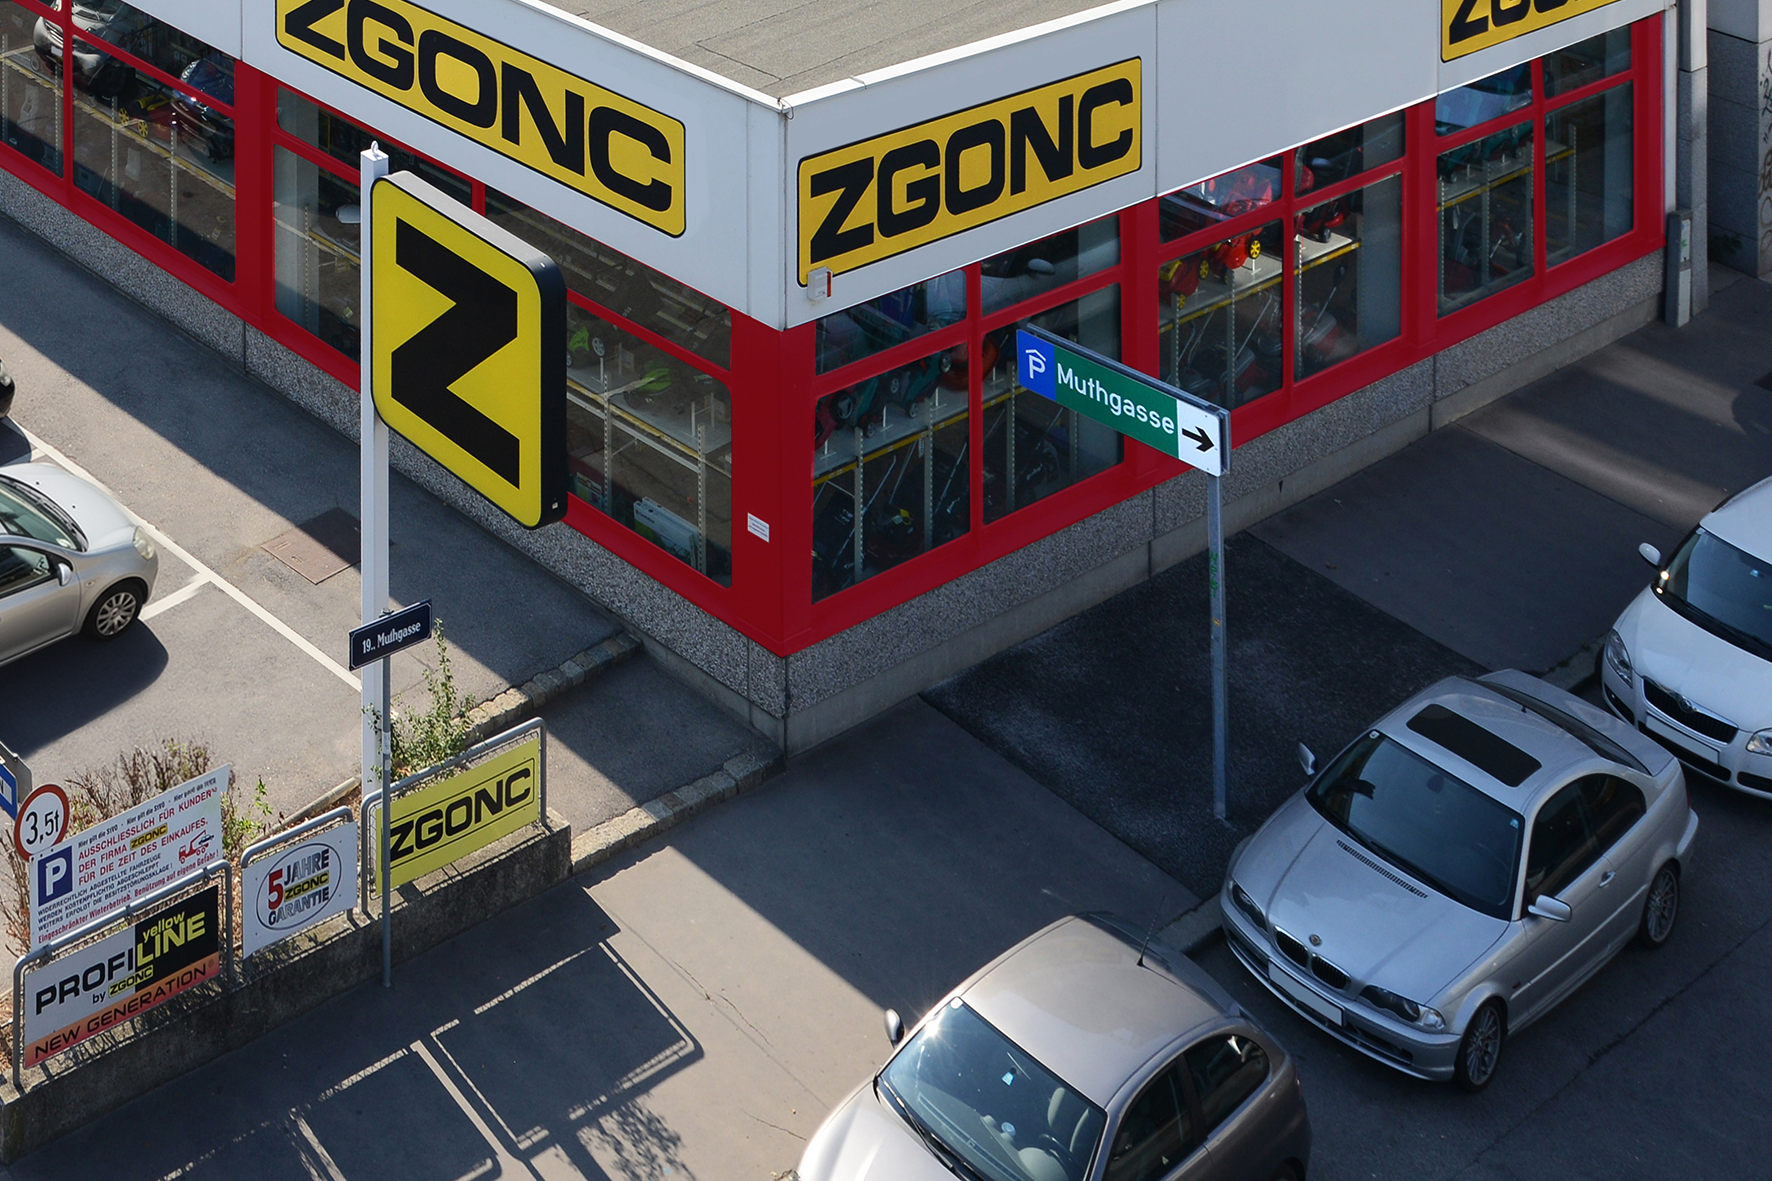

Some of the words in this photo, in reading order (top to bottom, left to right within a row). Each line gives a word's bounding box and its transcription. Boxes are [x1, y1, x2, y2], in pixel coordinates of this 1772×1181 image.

[810, 77, 1134, 265] ZGONC
[391, 216, 520, 490] Z
[1057, 363, 1175, 435] Muthgasse
[377, 622, 421, 649] Muthgasse
[26, 809, 59, 845] 3,5t
[78, 817, 155, 861] AUSSCHLIESSLICH
[159, 807, 175, 822] FÜR
[390, 766, 531, 863] ZGONC
[78, 858, 96, 873] DER
[100, 844, 127, 863] FIRMA
[131, 825, 167, 849] ZGONC
[78, 871, 96, 886] FÜR
[100, 862, 114, 876] DIE
[118, 851, 136, 867] ZEIT
[140, 842, 157, 856] DES
[161, 817, 208, 846] EINKAUFES.
[38, 888, 88, 916] WIDERRECHTLICH
[90, 870, 127, 892] ABGESTELLTE
[129, 852, 161, 872] FAHRZEUGE
[38, 908, 63, 924] WERDEN
[64, 883, 115, 911] KOSTENPFLICHTIG
[117, 861, 159, 887] ABGESCHLEPPT
[45, 856, 68, 897] P
[268, 868, 283, 910] 5
[284, 848, 329, 886] JAHRE
[285, 872, 328, 900] ZGONC
[38, 915, 64, 932] WEITERS
[65, 901, 91, 919] ERFOLGT
[93, 897, 103, 906] DIE
[38, 914, 88, 944] Eingeschränkter
[142, 911, 186, 943] yellow
[268, 886, 329, 926] GARANTIE
[35, 1026, 81, 1059] NEW
[87, 963, 206, 1032] GENERATION
[92, 990, 107, 1005] by
[110, 966, 154, 996] ZGONC
